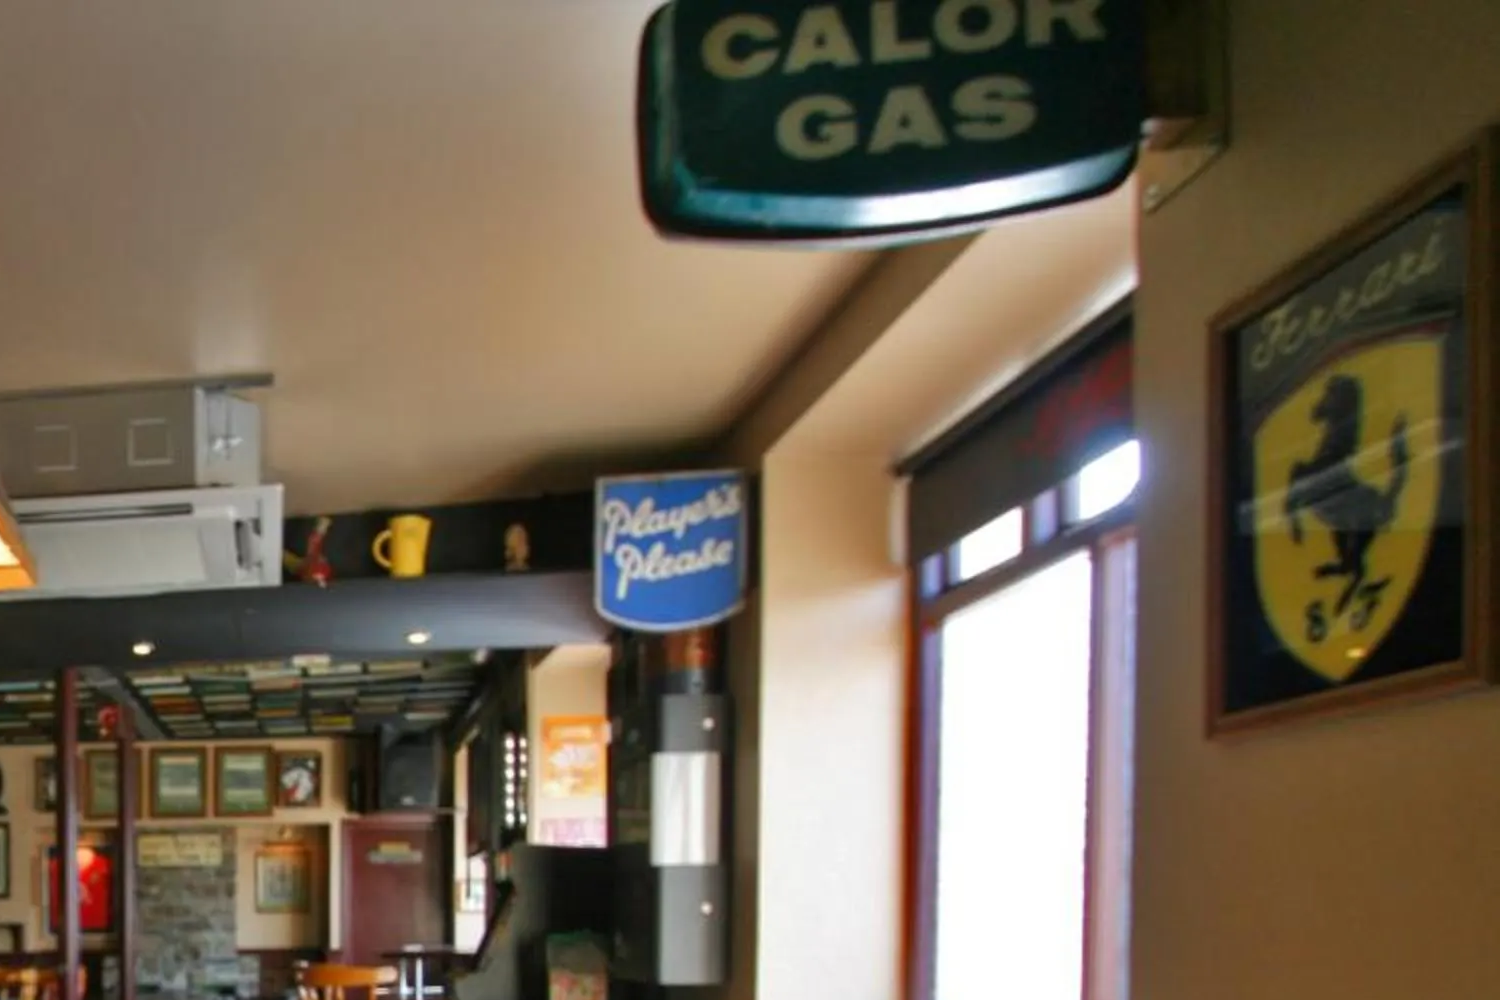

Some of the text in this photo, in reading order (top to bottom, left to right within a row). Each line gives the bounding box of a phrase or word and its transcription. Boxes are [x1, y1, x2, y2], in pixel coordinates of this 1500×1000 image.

[702, 0, 1107, 79] CALOR
[776, 74, 1038, 161] GAS
[1250, 216, 1446, 371] Ferrari
[614, 537, 734, 600] Please
